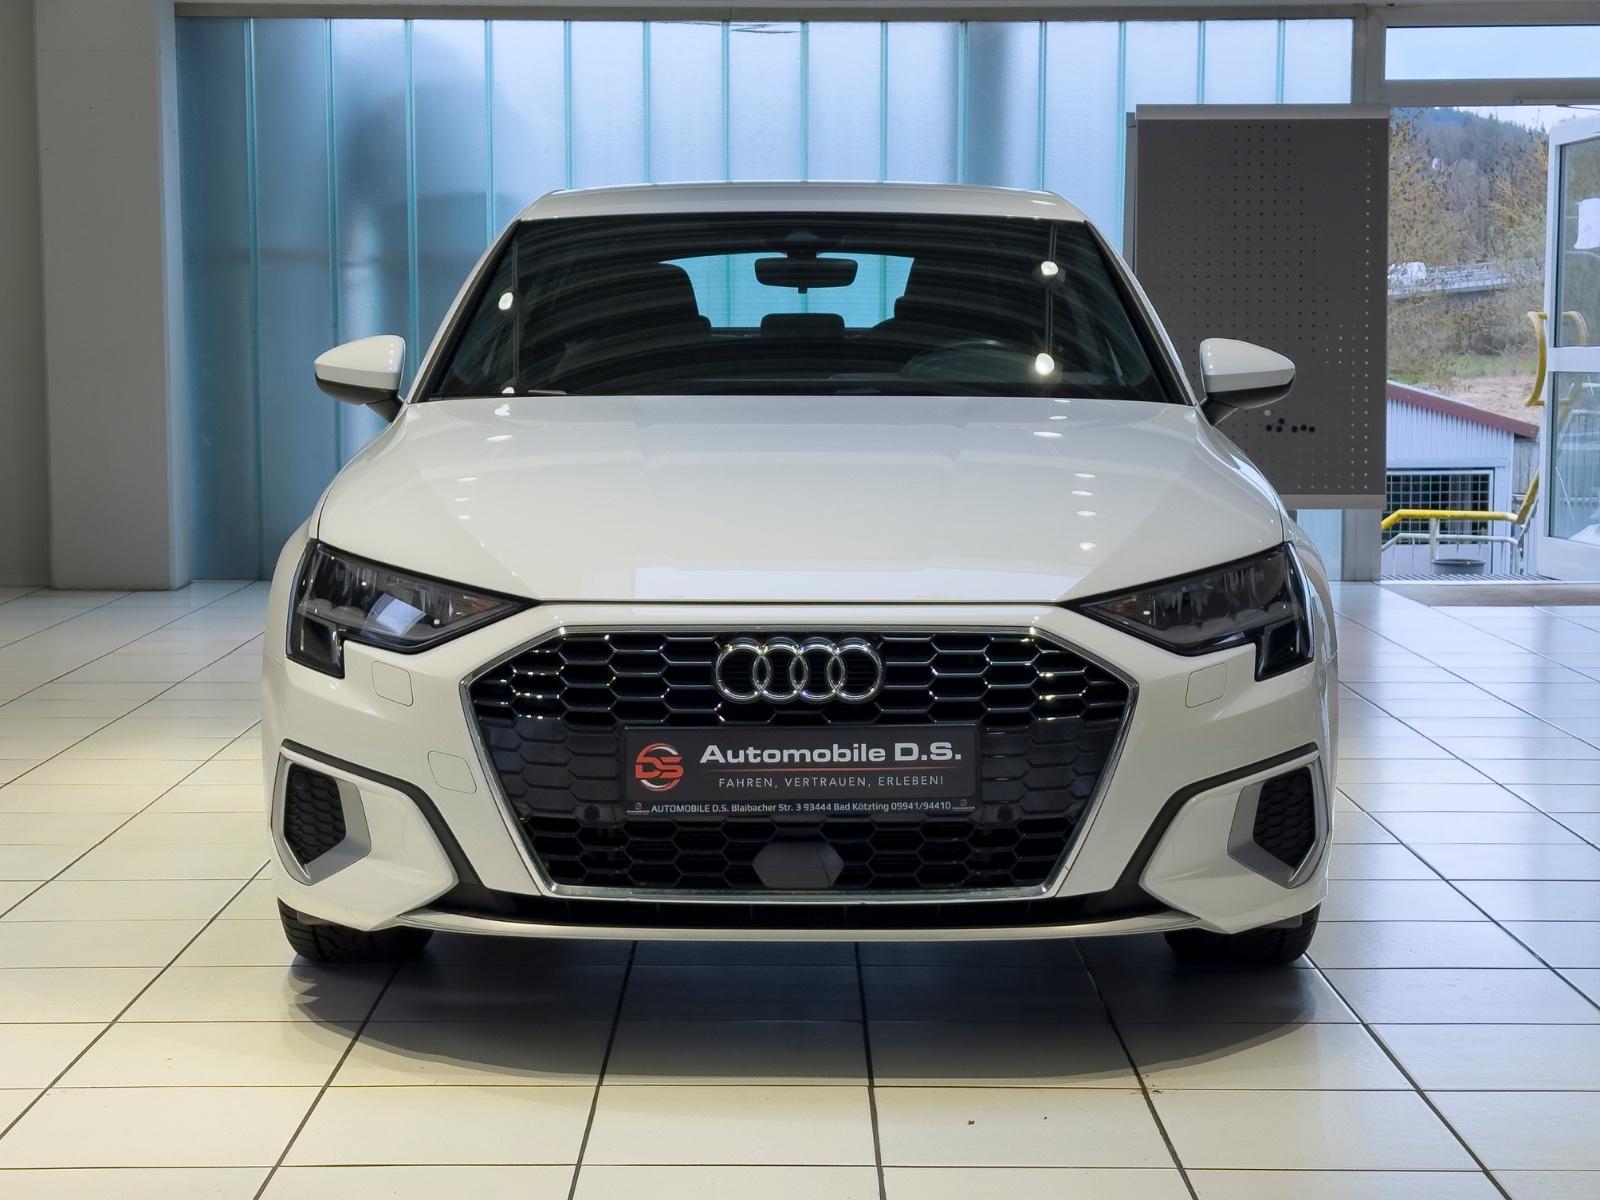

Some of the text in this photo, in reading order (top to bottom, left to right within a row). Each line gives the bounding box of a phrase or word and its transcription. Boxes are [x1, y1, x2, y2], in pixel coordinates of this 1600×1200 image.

[700, 742, 962, 764] Automobile D.S.
[634, 756, 684, 779] DS
[718, 776, 943, 789] FAHREN, VERTRAUEN, ERLEBEN!
[651, 804, 710, 813] AUTOMOBILE
[712, 804, 730, 813] D.S.
[731, 803, 776, 812] Blaibacher
[778, 803, 795, 812] Str.
[796, 803, 802, 812] 3
[803, 803, 831, 812] 93444
[833, 802, 851, 812] Bad
[852, 802, 890, 813] Kötzting
[891, 801, 951, 811] 09941/94410
